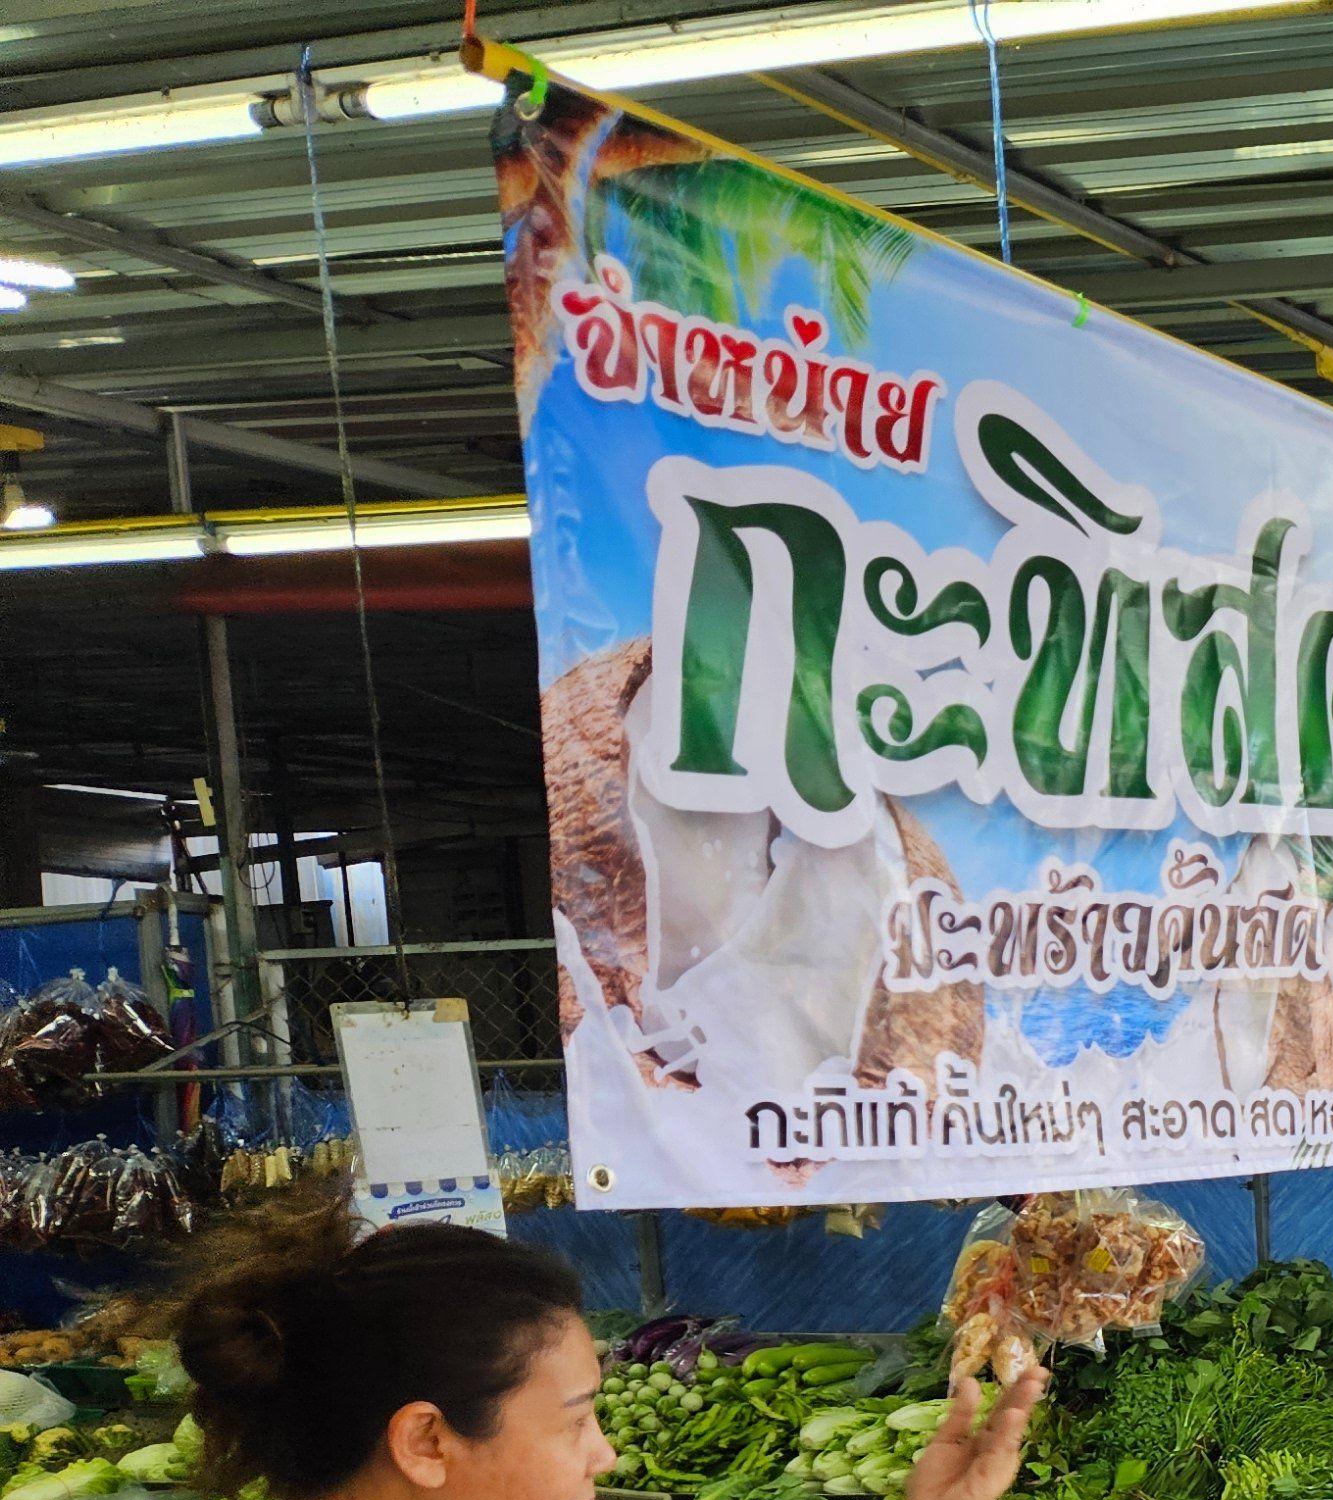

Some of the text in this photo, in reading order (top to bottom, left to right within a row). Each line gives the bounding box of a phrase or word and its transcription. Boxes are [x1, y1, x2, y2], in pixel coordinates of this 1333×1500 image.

[560, 265, 941, 464] จำหน่าย
[888, 847, 1325, 988] มะพร้าวคั้นสด
[744, 1081, 919, 1149] กะทิแท้
[942, 1063, 1106, 1156] คั้นใหม่ๆ
[1121, 1096, 1236, 1140] สะอาด
[1250, 1096, 1296, 1137] สด
